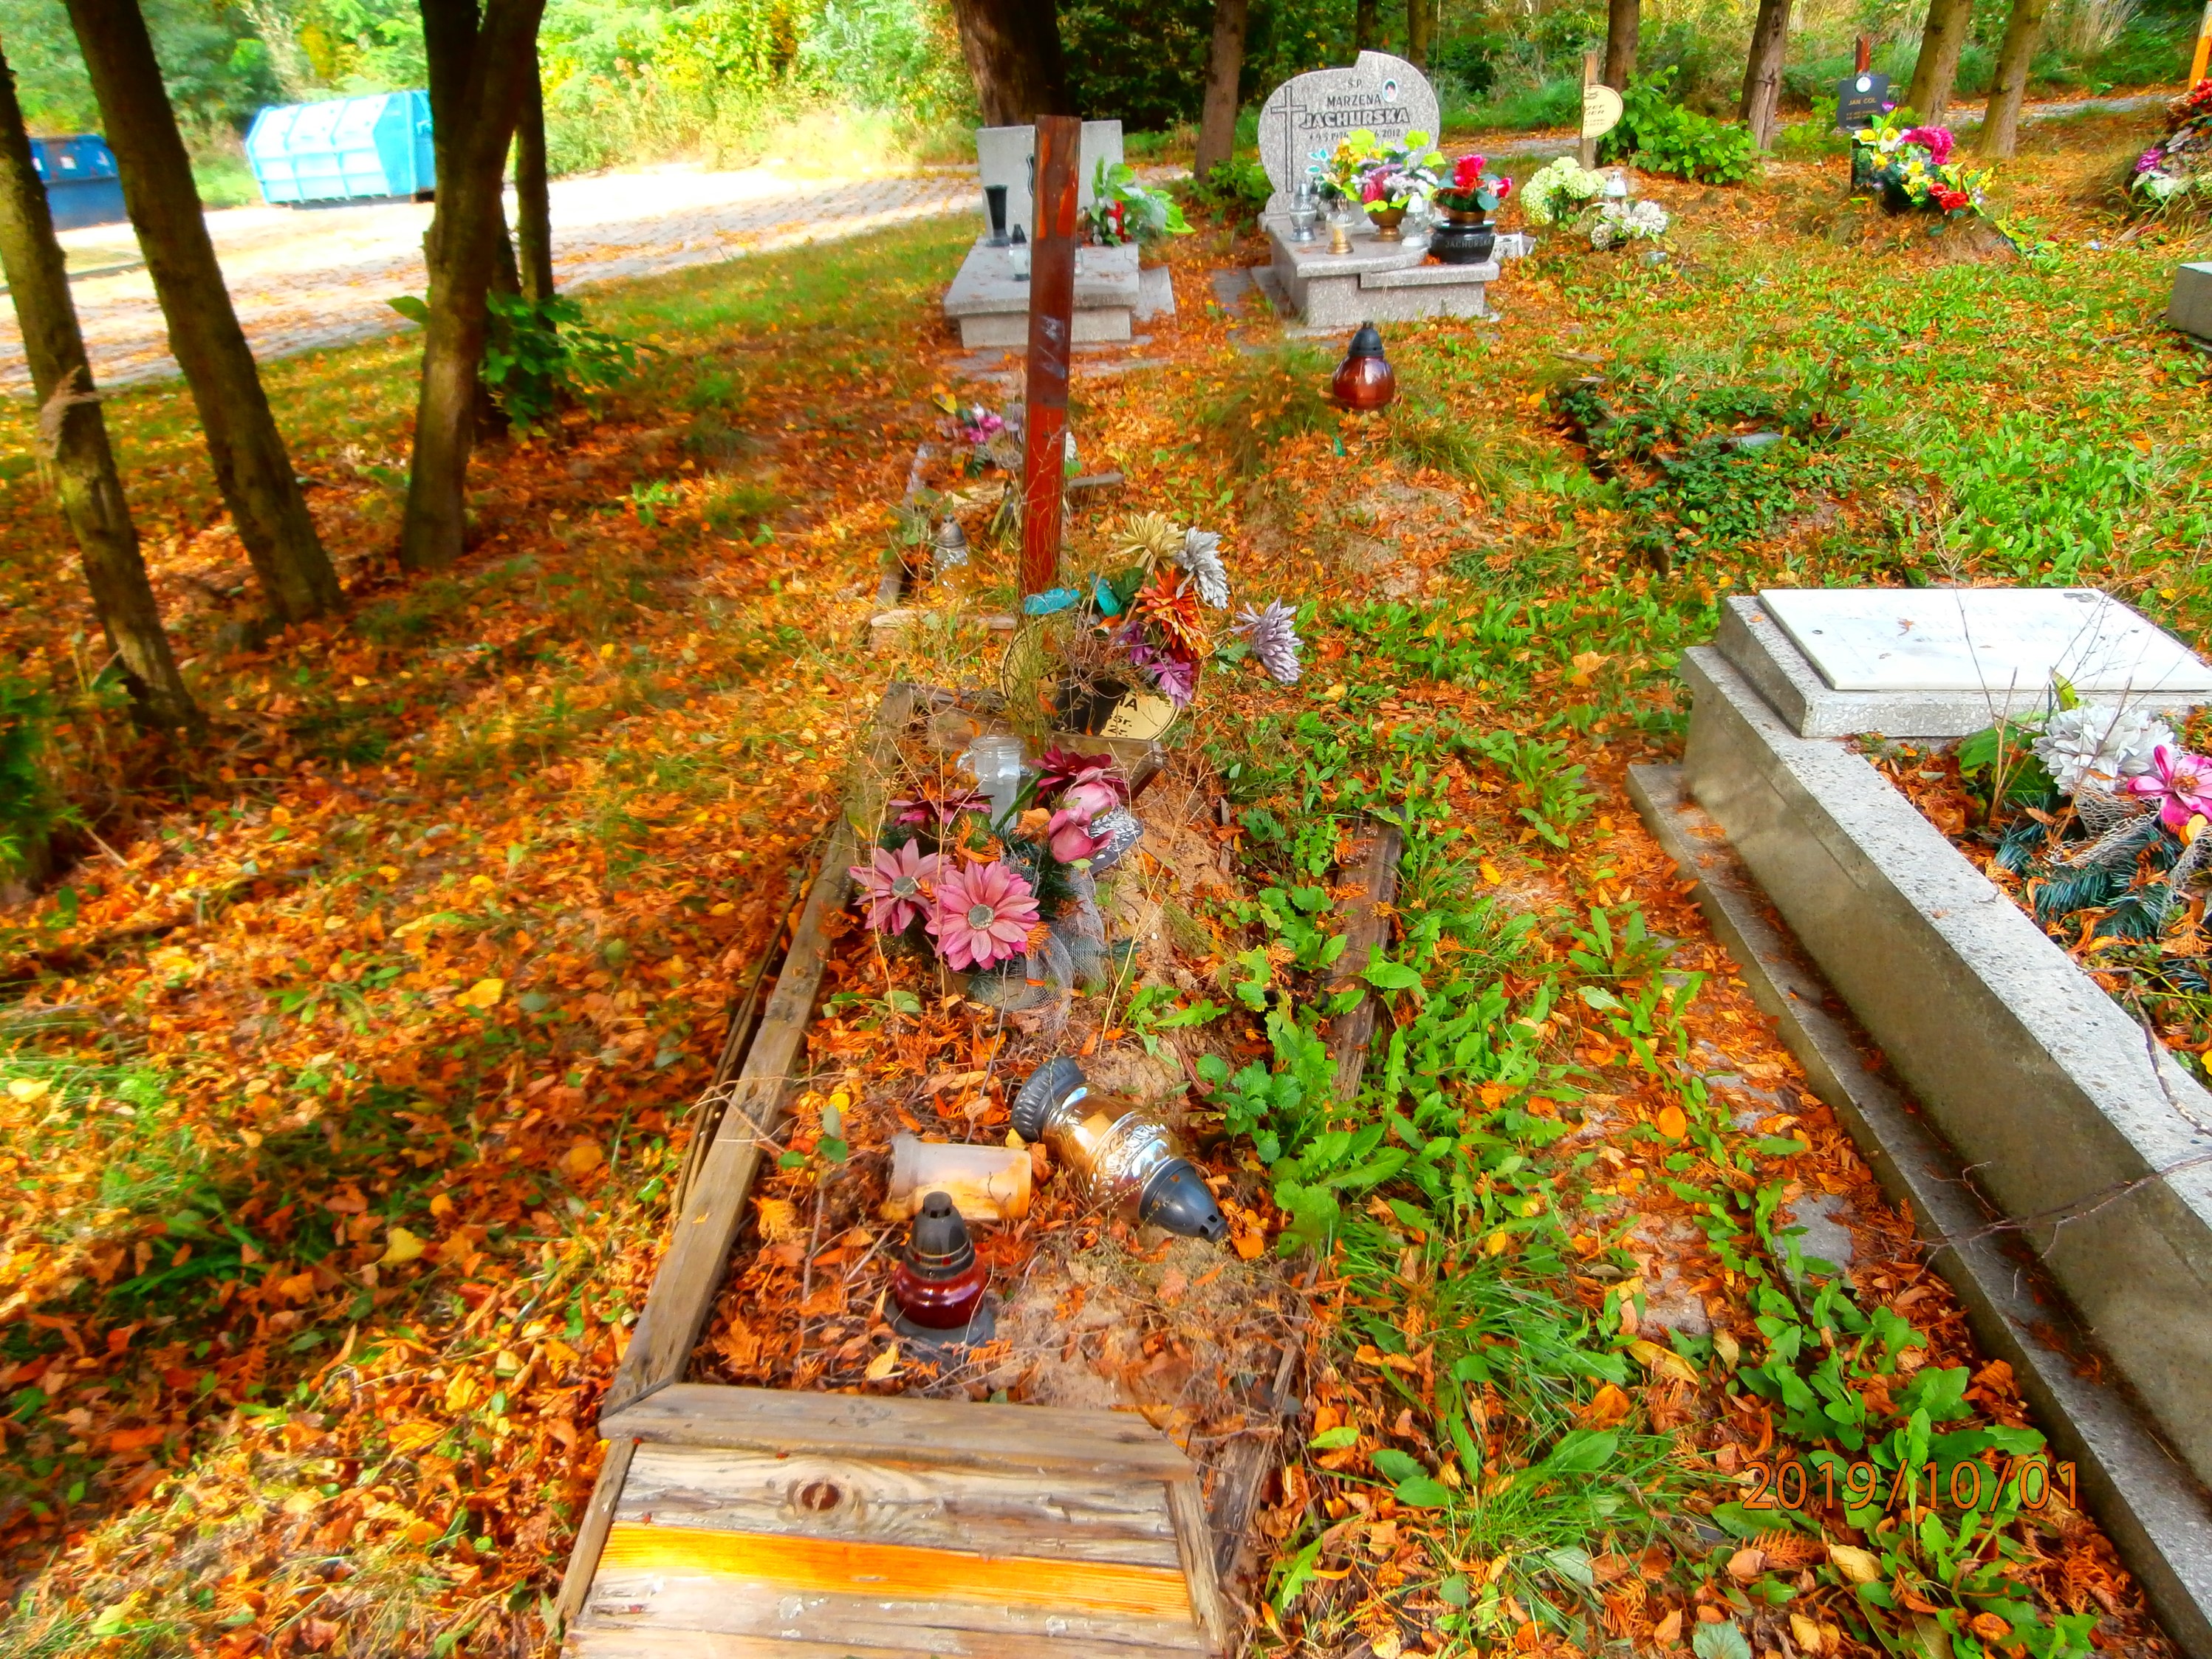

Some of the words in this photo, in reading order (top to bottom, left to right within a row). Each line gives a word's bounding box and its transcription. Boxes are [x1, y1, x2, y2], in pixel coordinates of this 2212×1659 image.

[1326, 94, 1381, 107] MARZENA
[1298, 107, 1411, 129] JACHURSKA
[1445, 238, 1492, 249] JACHURSKA
